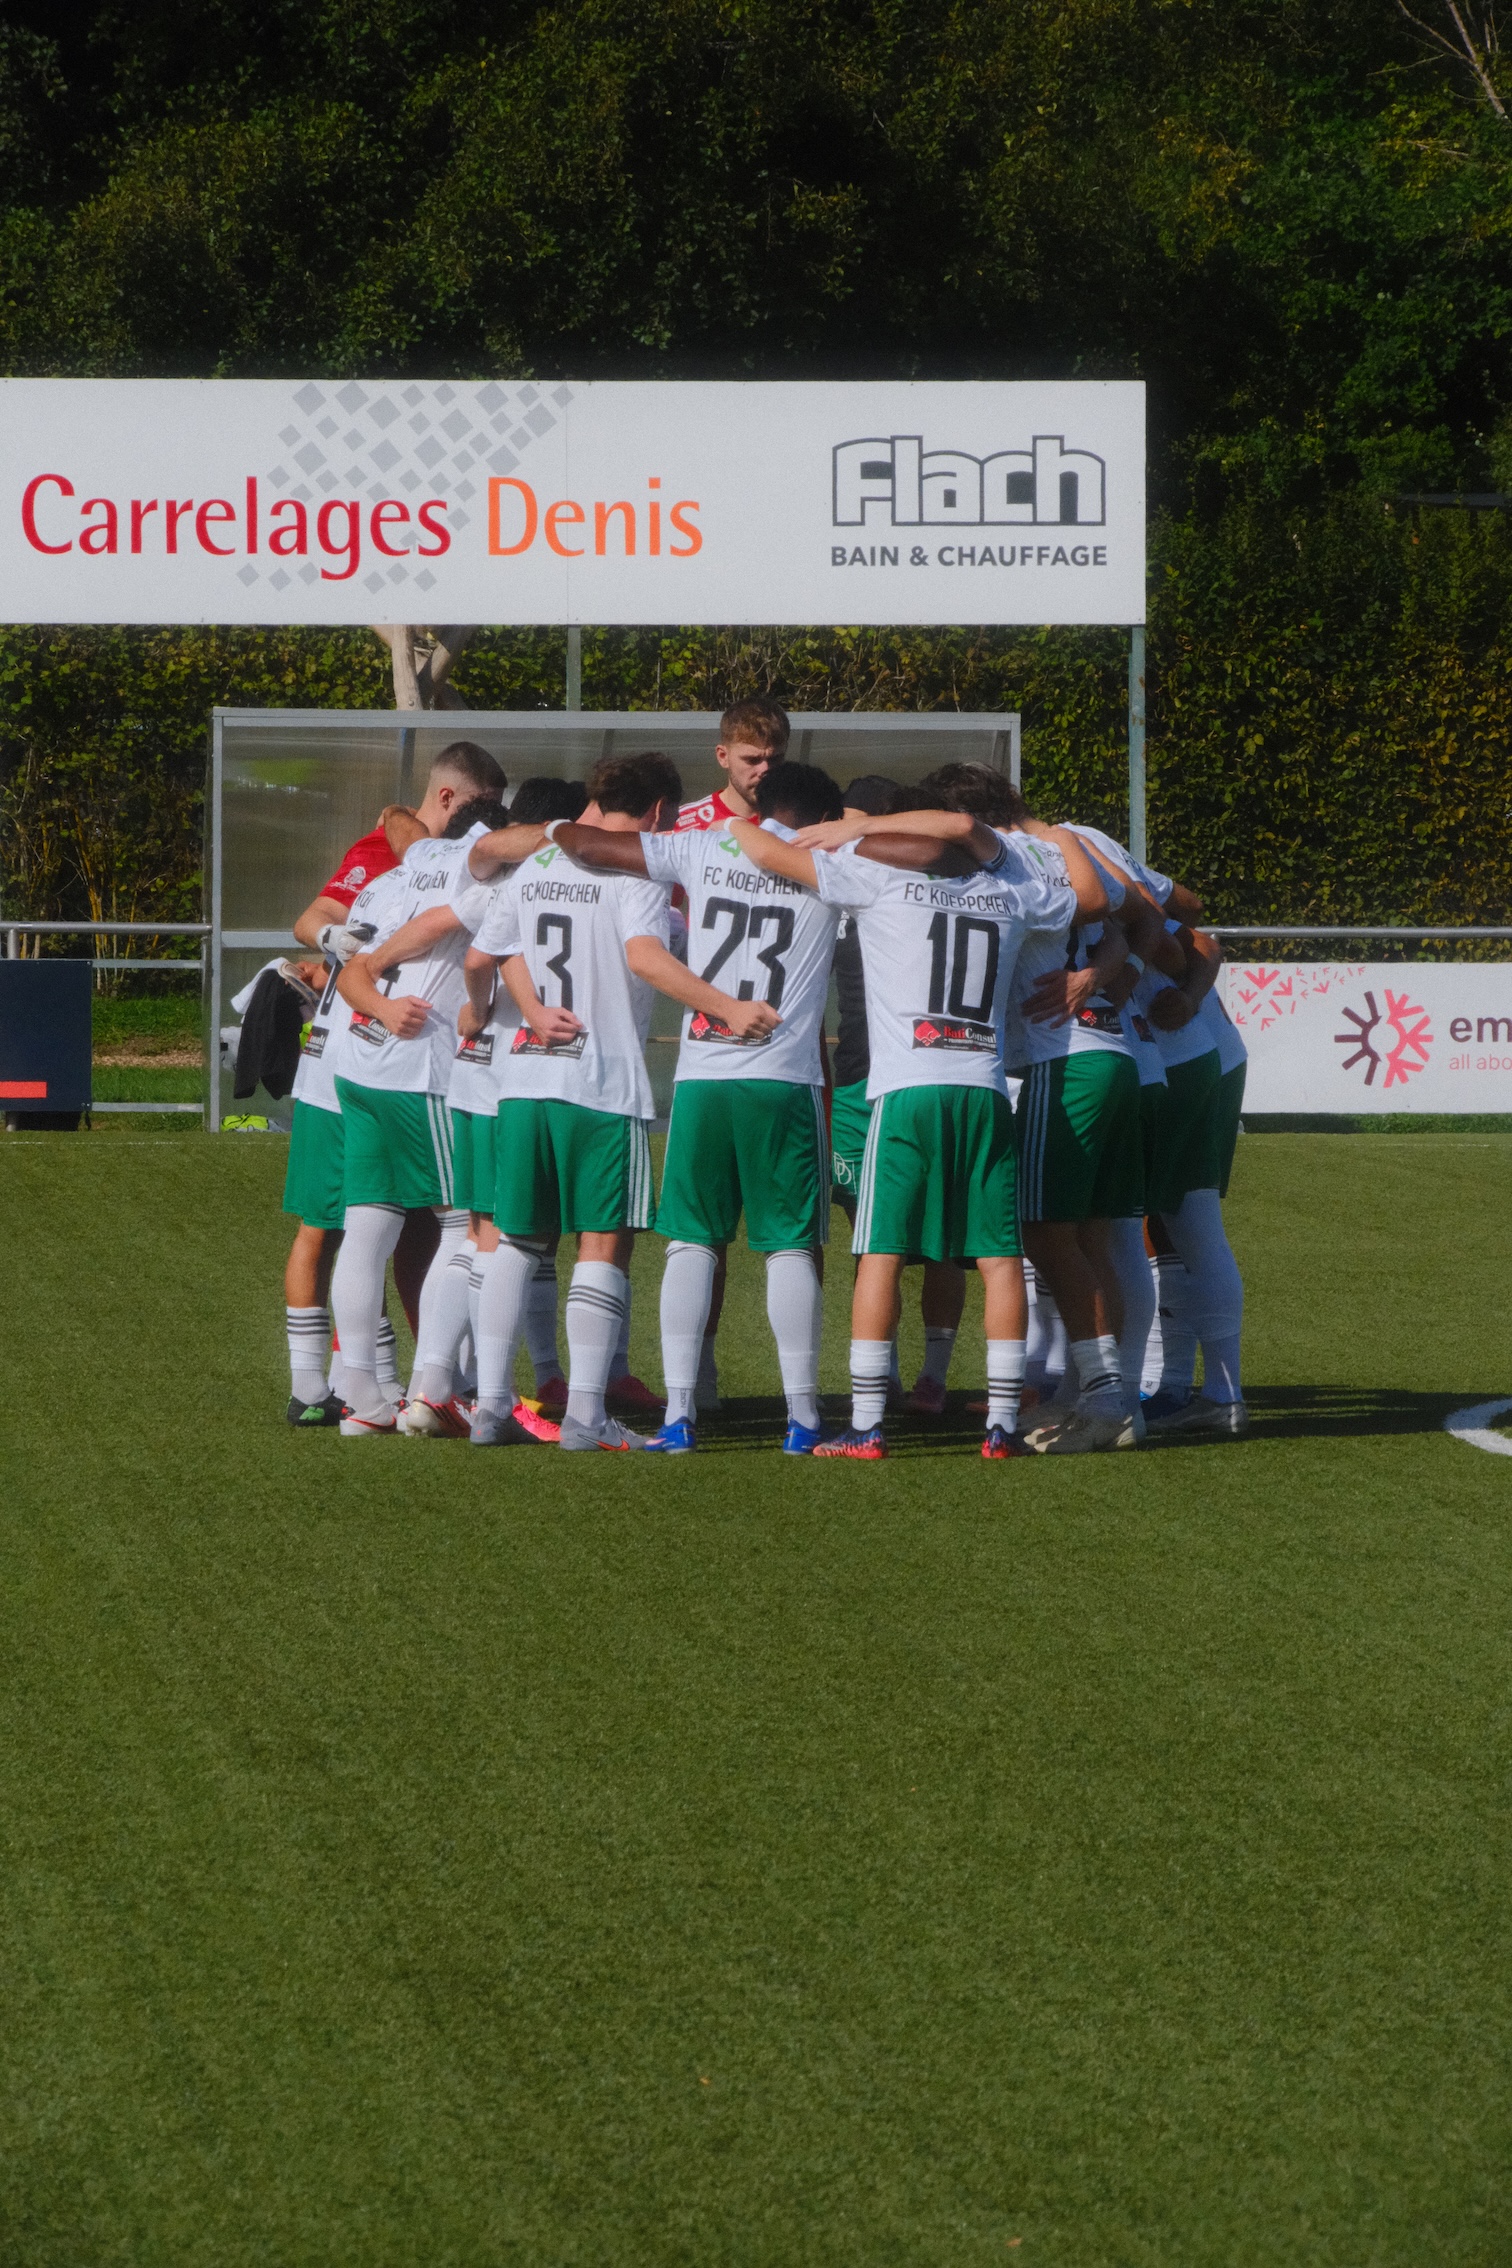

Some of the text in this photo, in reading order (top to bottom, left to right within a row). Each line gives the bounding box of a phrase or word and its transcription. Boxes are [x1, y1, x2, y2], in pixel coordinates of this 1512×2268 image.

[832, 435, 1106, 526] Flach
[21, 473, 703, 580] Carrelages Denis
[831, 545, 1108, 567] BAIN & CHAUFFAGE
[521, 882, 534, 904] FC
[703, 866, 722, 886] FC
[904, 882, 1012, 916] FC KOEPPCHEN
[536, 912, 573, 1012] 3
[701, 896, 795, 1011] 23
[926, 910, 999, 1023] 10
[1450, 1017, 1512, 1043] em
[1449, 1054, 1512, 1070] all abo
